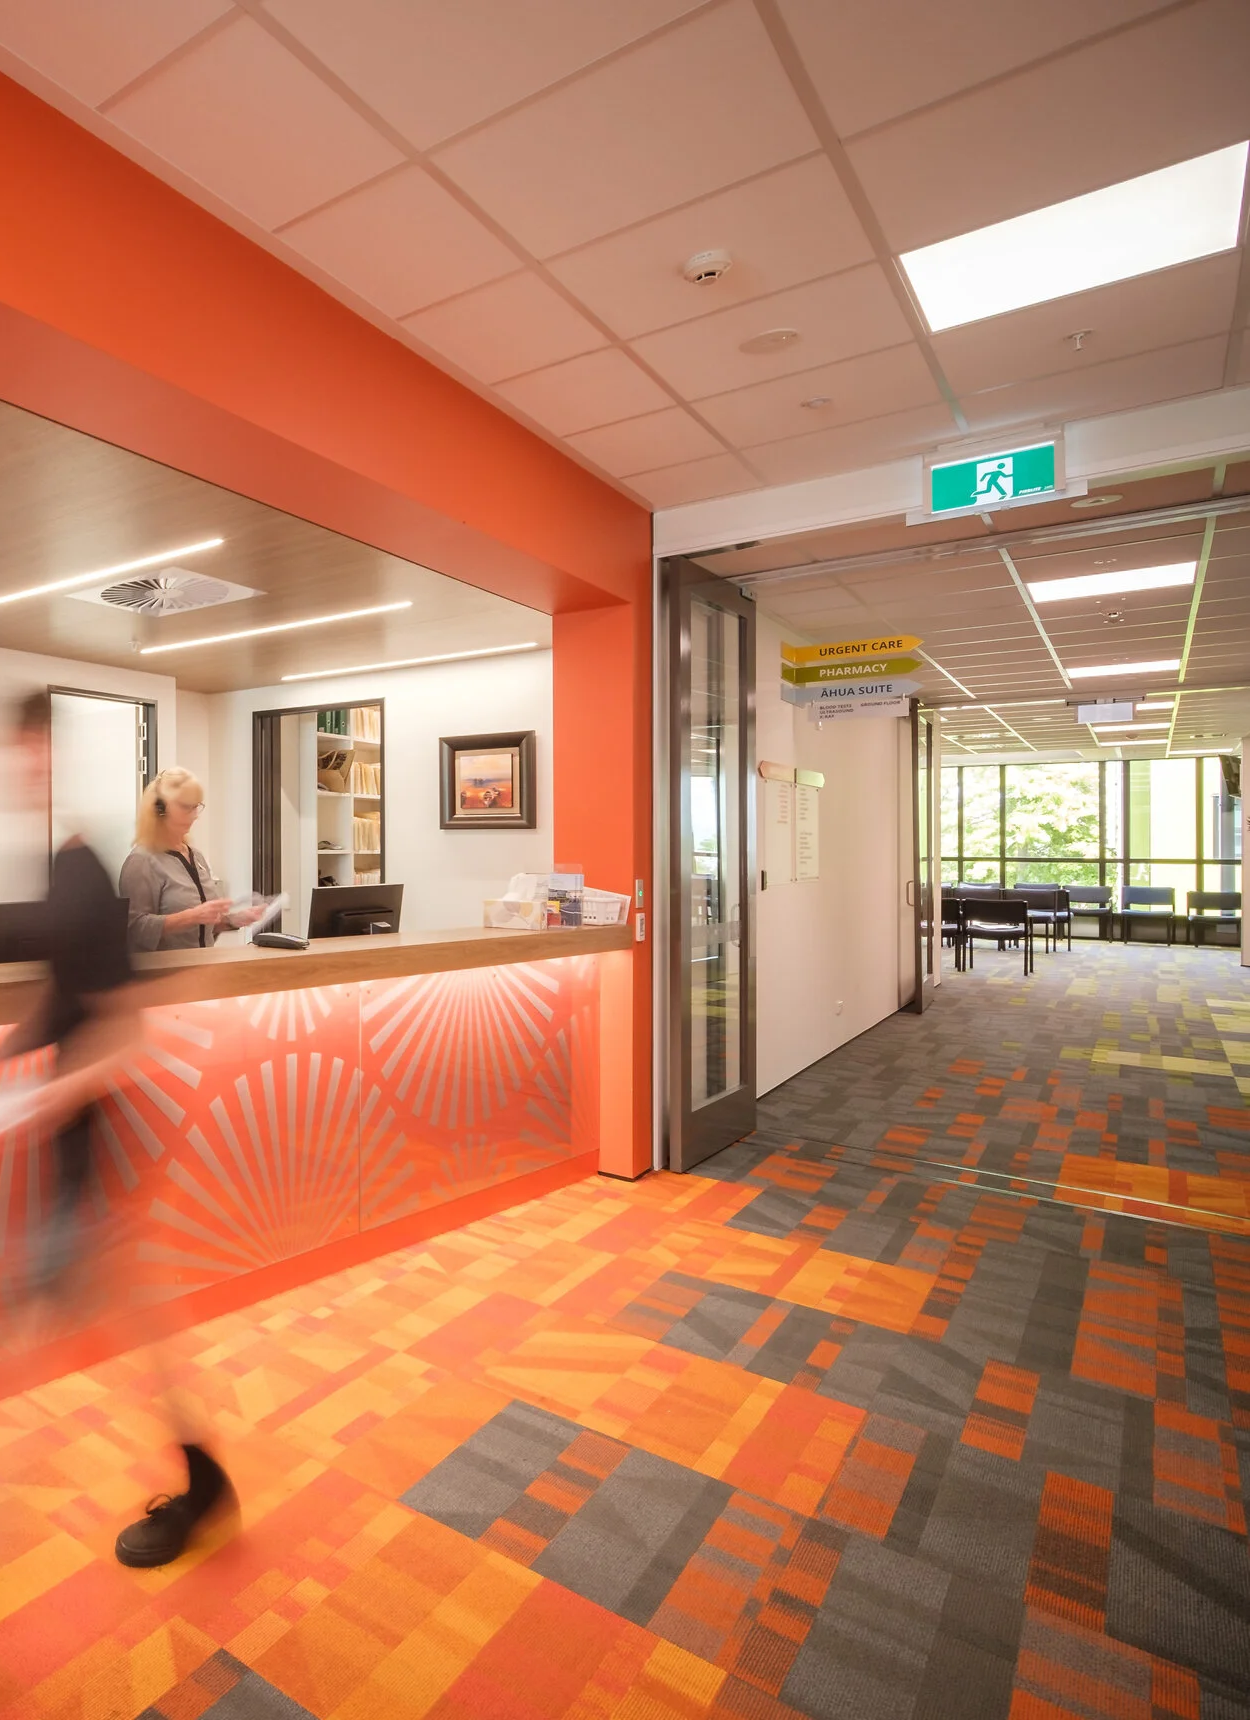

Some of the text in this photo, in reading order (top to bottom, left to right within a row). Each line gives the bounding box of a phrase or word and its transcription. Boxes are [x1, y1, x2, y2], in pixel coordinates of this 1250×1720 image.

[819, 640, 903, 656] URGENT CARE
[819, 663, 887, 677] PHARMACY
[858, 684, 893, 695] SUITE
